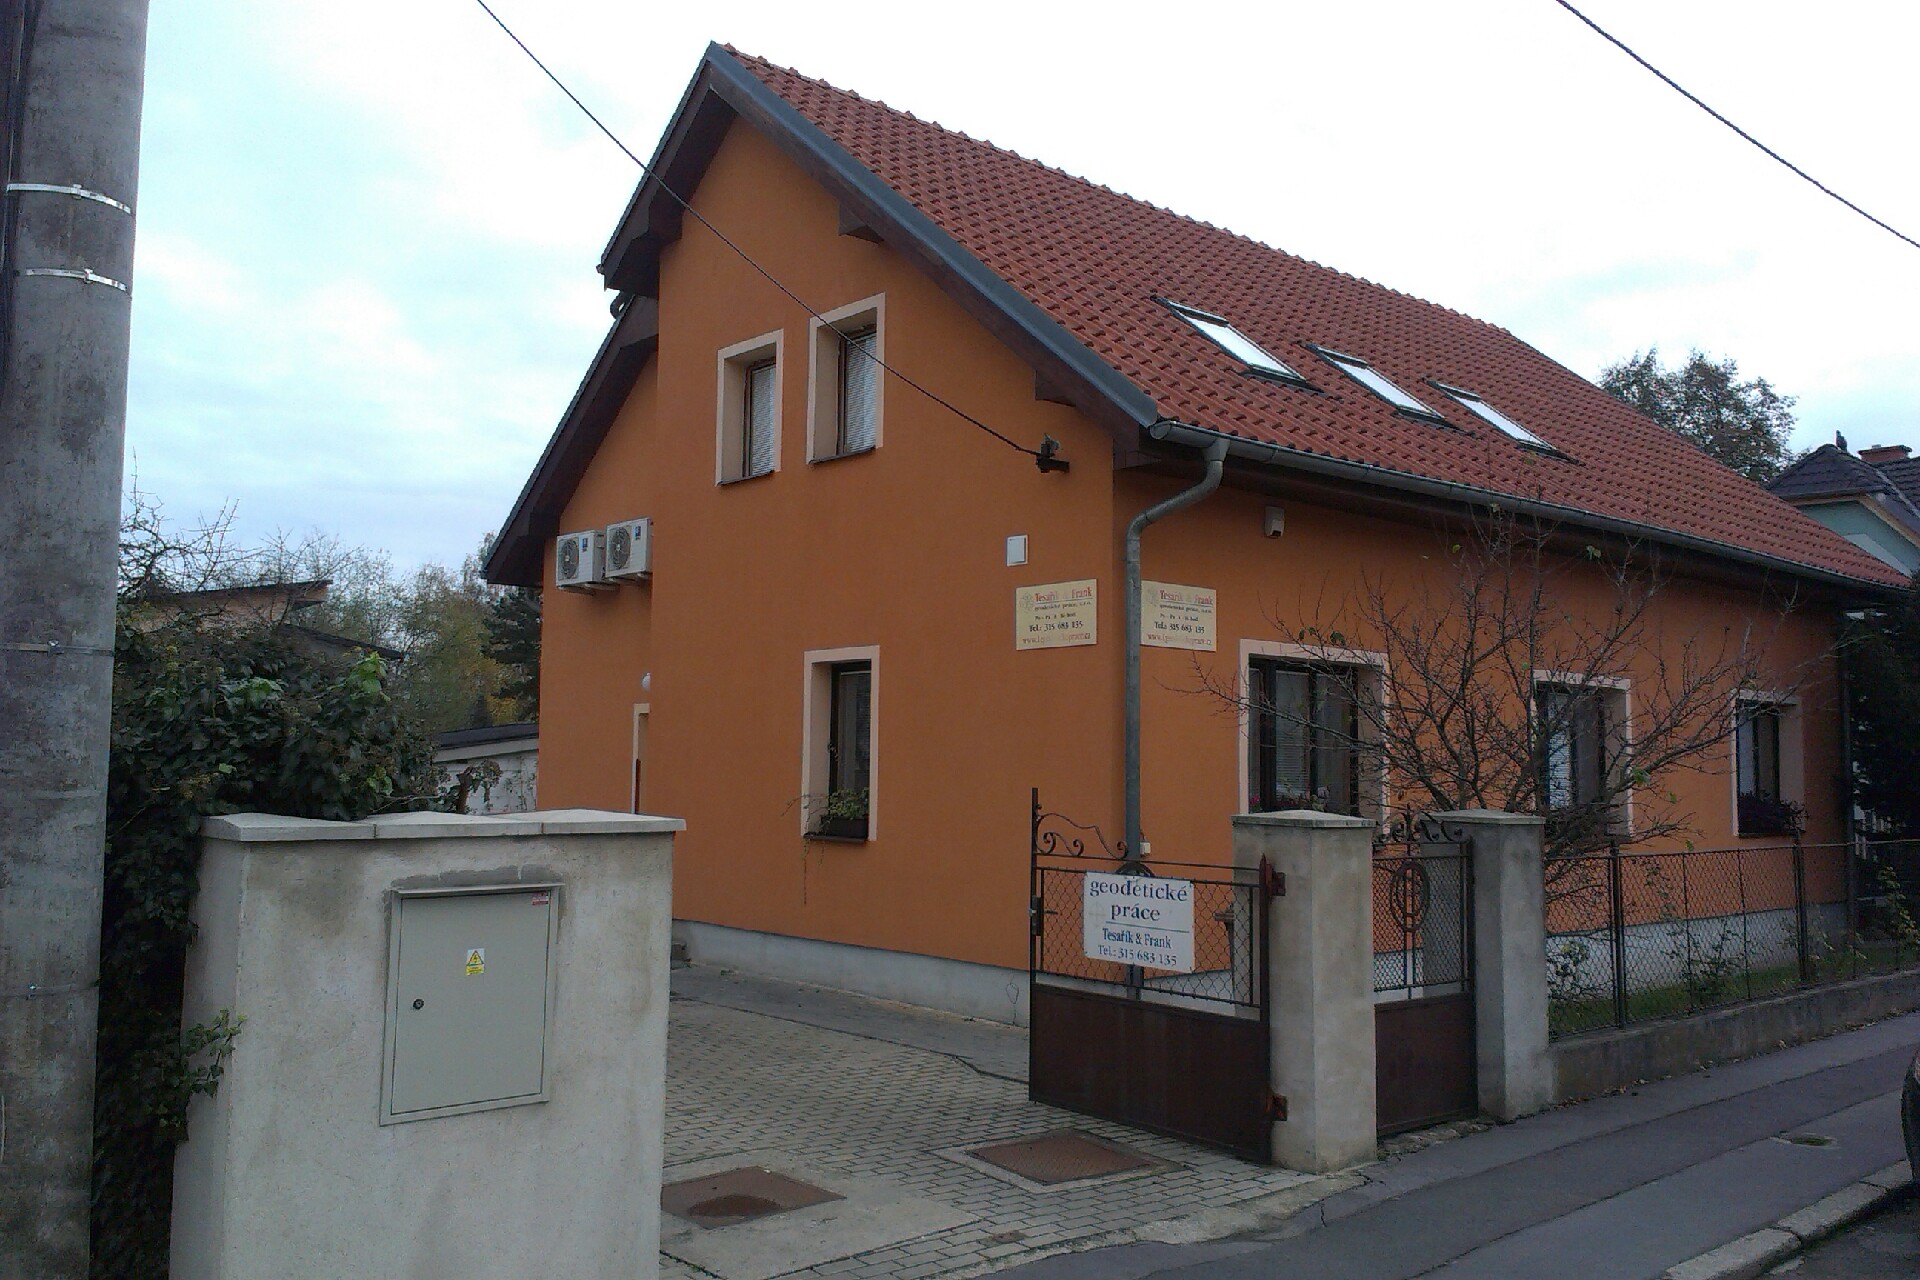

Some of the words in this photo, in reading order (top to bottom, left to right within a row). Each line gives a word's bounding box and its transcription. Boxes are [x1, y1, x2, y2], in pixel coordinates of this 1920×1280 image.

[1072, 586, 1092, 598] Frank
[1044, 623, 1055, 632] 315
[1058, 622, 1069, 630] 683
[1072, 620, 1083, 629] 135
[1181, 624, 1192, 633] 683
[1090, 880, 1188, 902] geodetické
[1112, 903, 1160, 921] práce
[1102, 928, 1134, 944] Tesařík
[1136, 932, 1142, 945] &
[1144, 934, 1172, 949] Frank
[1118, 948, 1134, 960] 315
[1137, 950, 1156, 964] 683
[1159, 954, 1177, 967] 135
